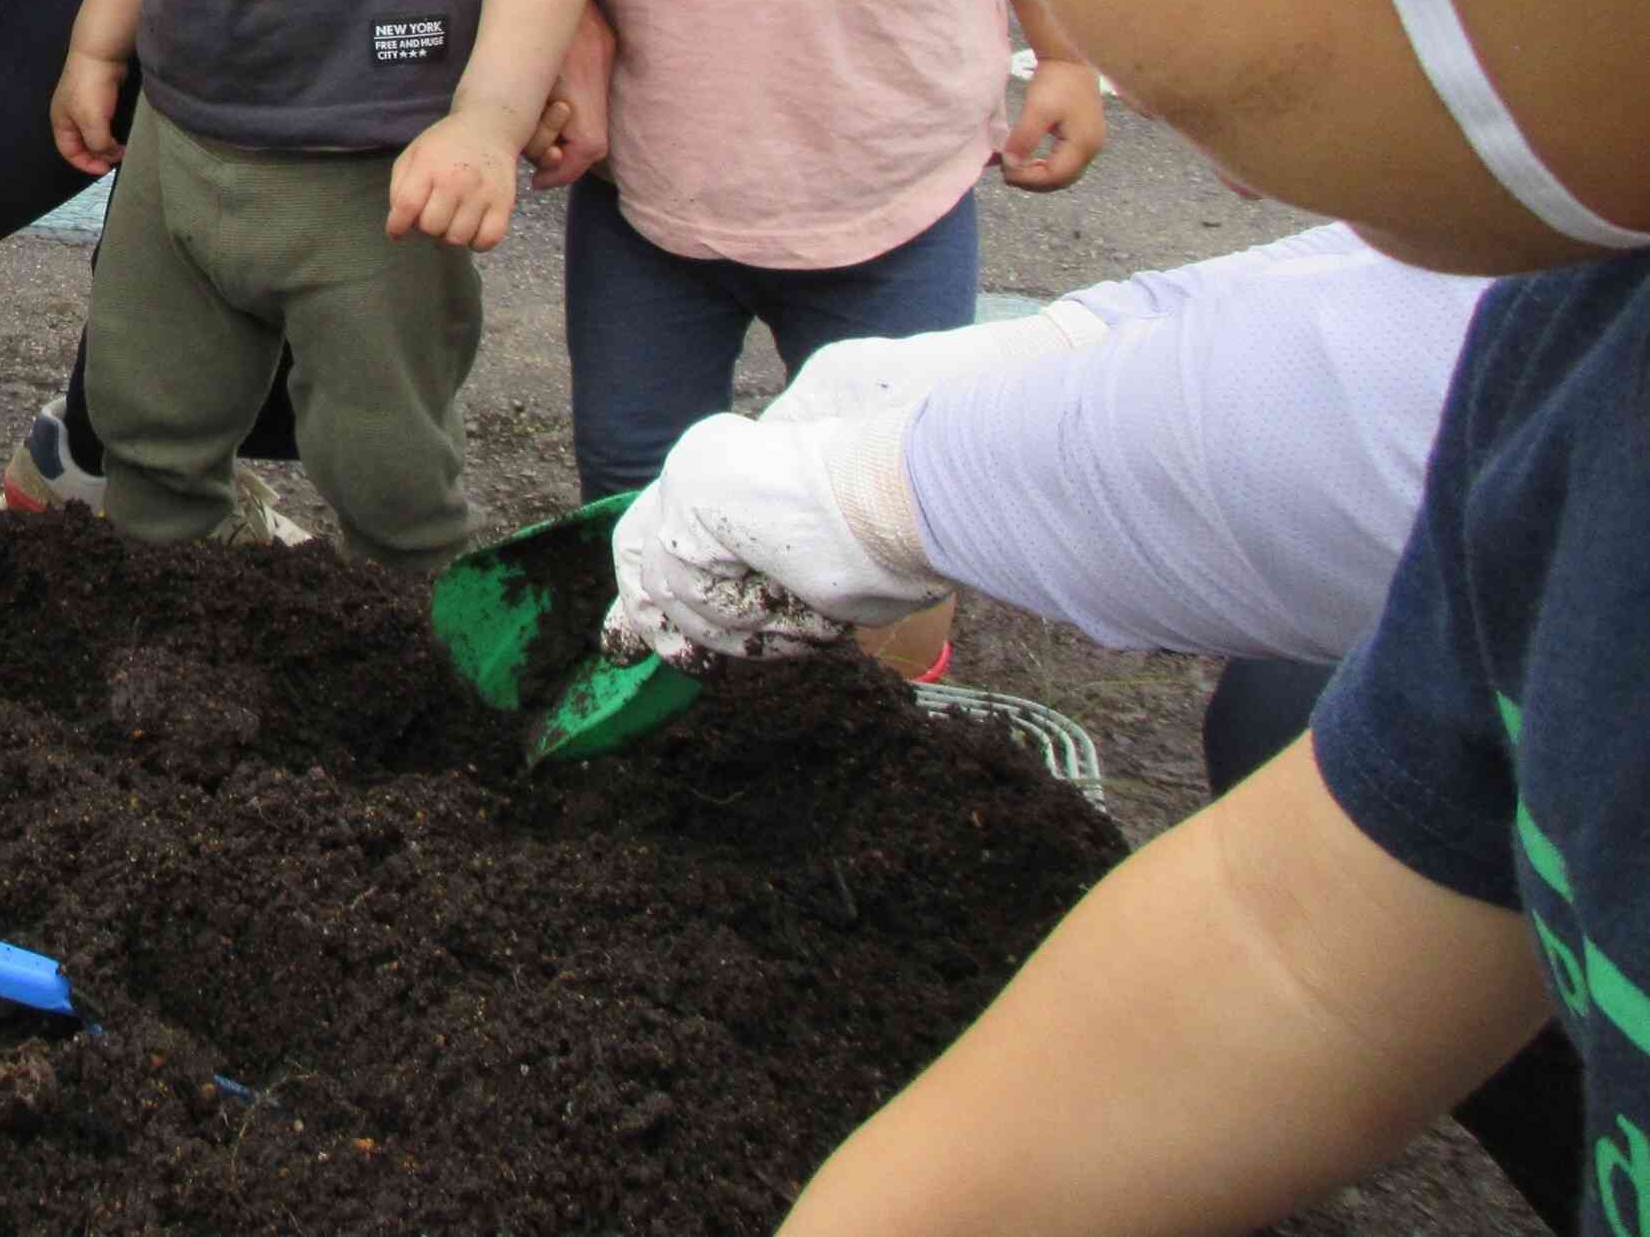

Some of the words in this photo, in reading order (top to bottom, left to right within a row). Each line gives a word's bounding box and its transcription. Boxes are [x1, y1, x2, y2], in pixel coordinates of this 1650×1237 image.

[375, 25, 407, 36] NEW
[409, 21, 442, 34] YORK
[375, 40, 397, 50] FREE
[399, 39, 419, 49] AND
[378, 51, 398, 60] CITY
